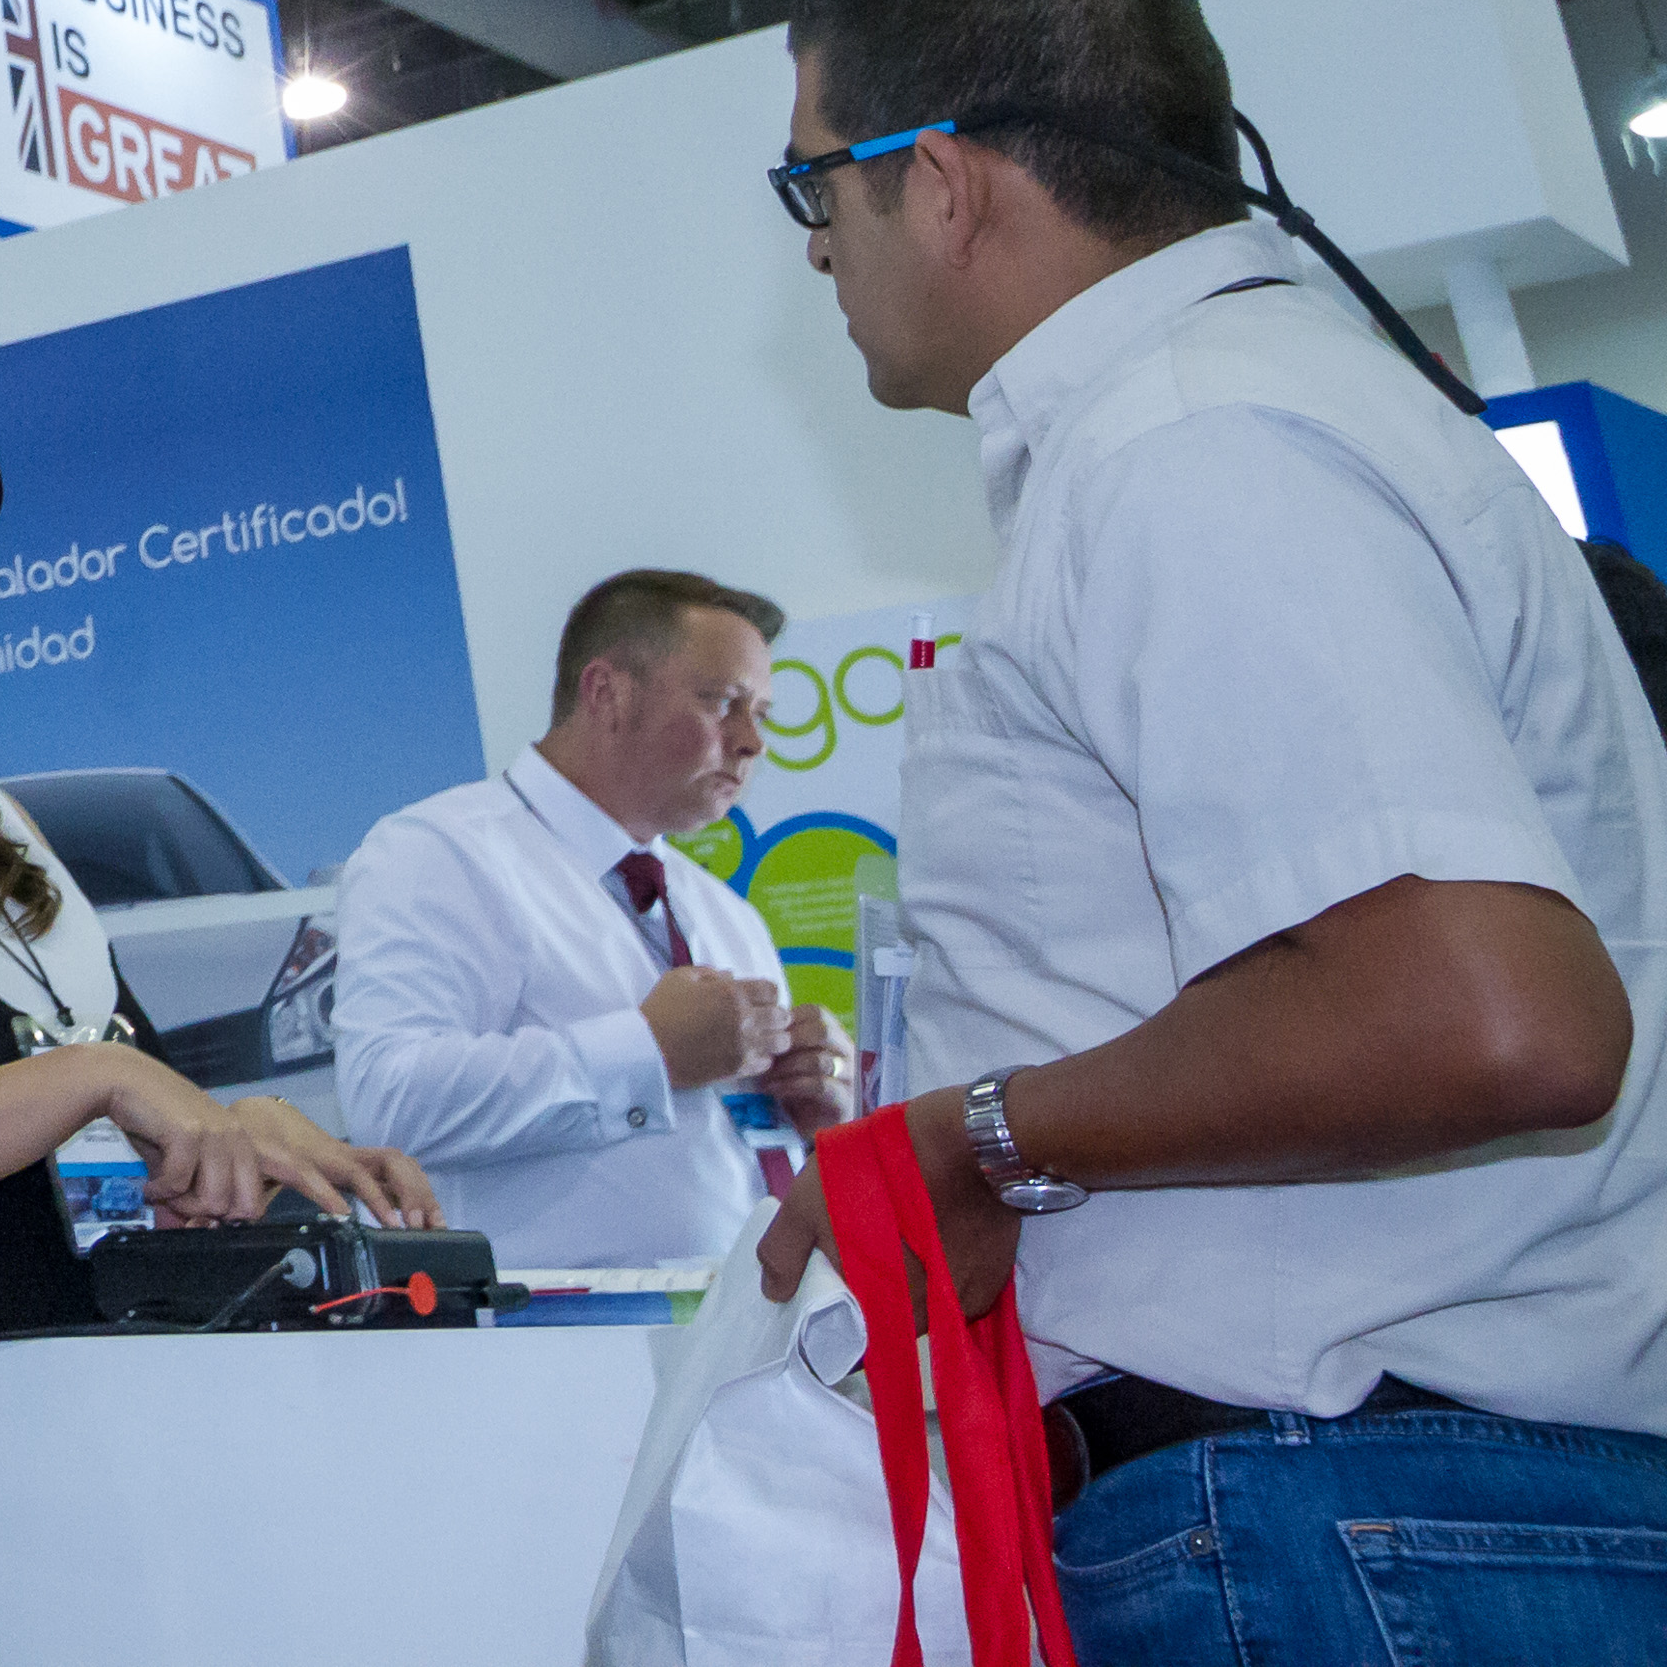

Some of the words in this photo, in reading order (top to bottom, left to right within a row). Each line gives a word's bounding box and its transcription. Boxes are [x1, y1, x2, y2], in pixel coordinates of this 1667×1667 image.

[51, 21, 90, 79] IS
[138, 476, 409, 570] Certificado!
[764, 634, 962, 772] go
